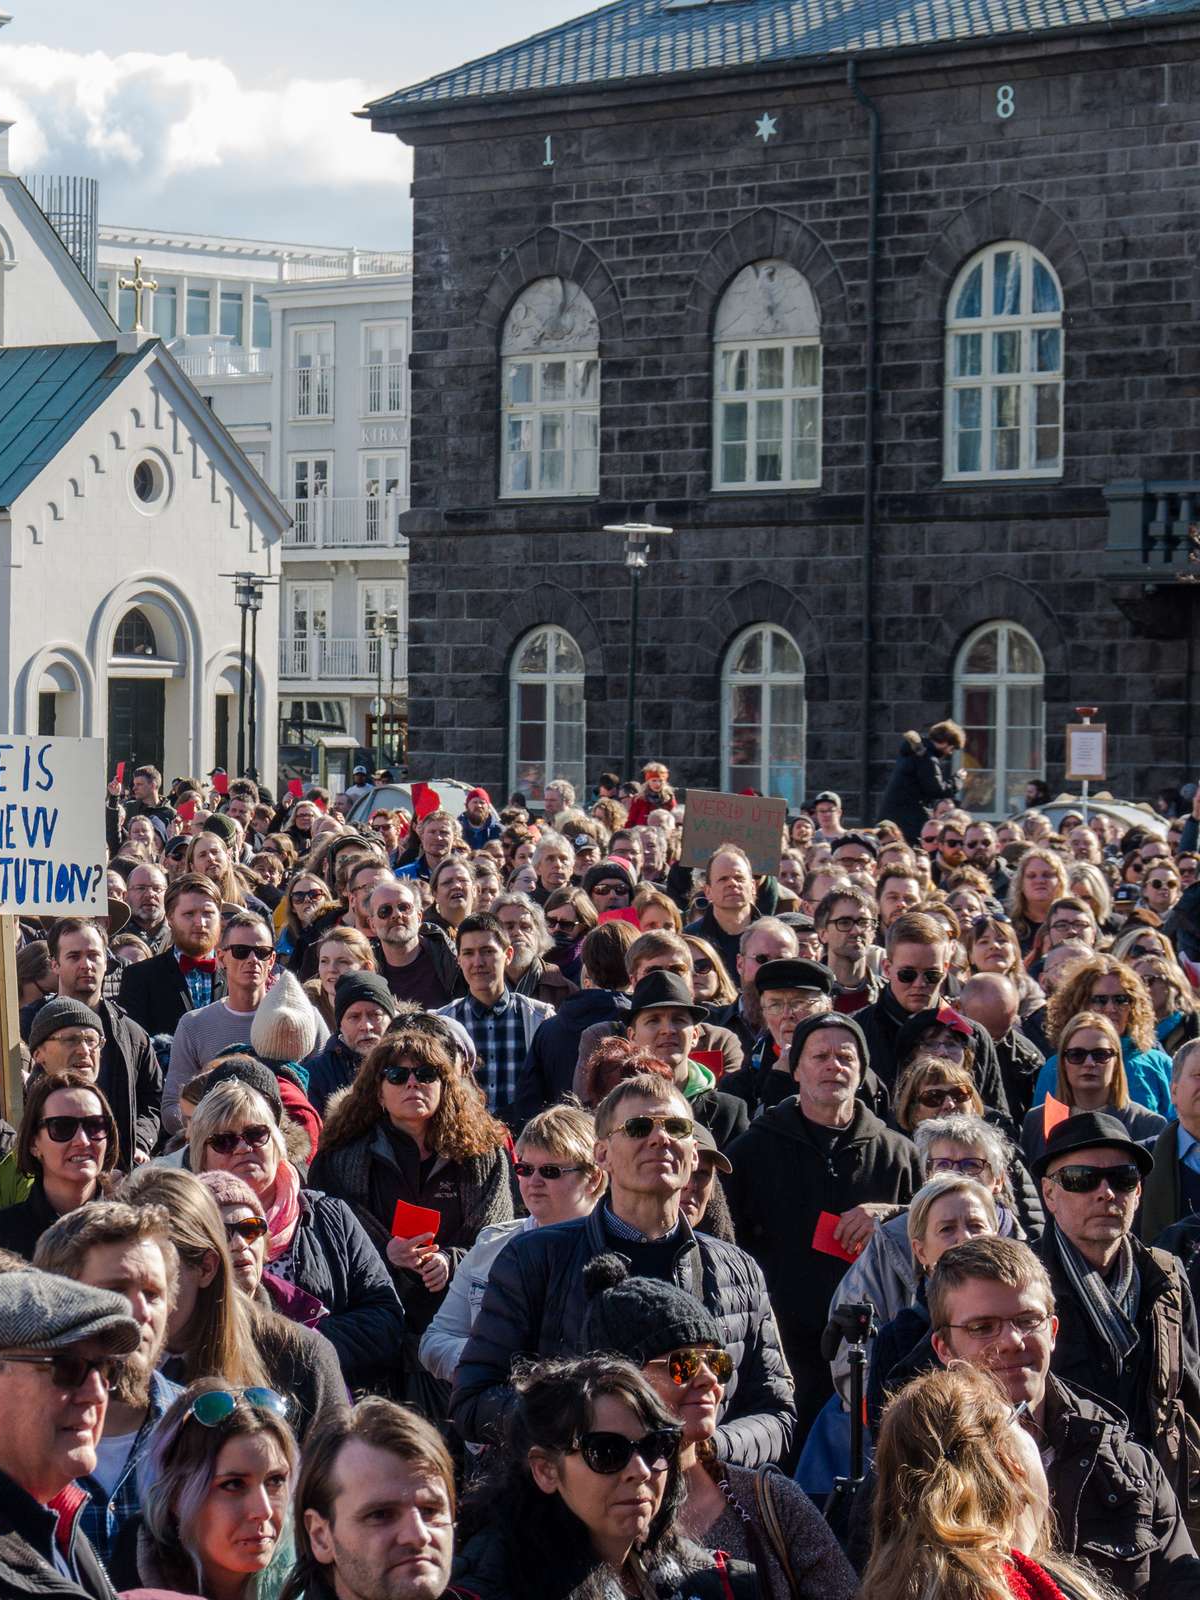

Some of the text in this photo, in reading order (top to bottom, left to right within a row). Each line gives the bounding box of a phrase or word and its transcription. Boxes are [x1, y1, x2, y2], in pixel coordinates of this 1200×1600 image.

[543, 85, 1015, 166] 1 8
[23, 743, 54, 791] IS
